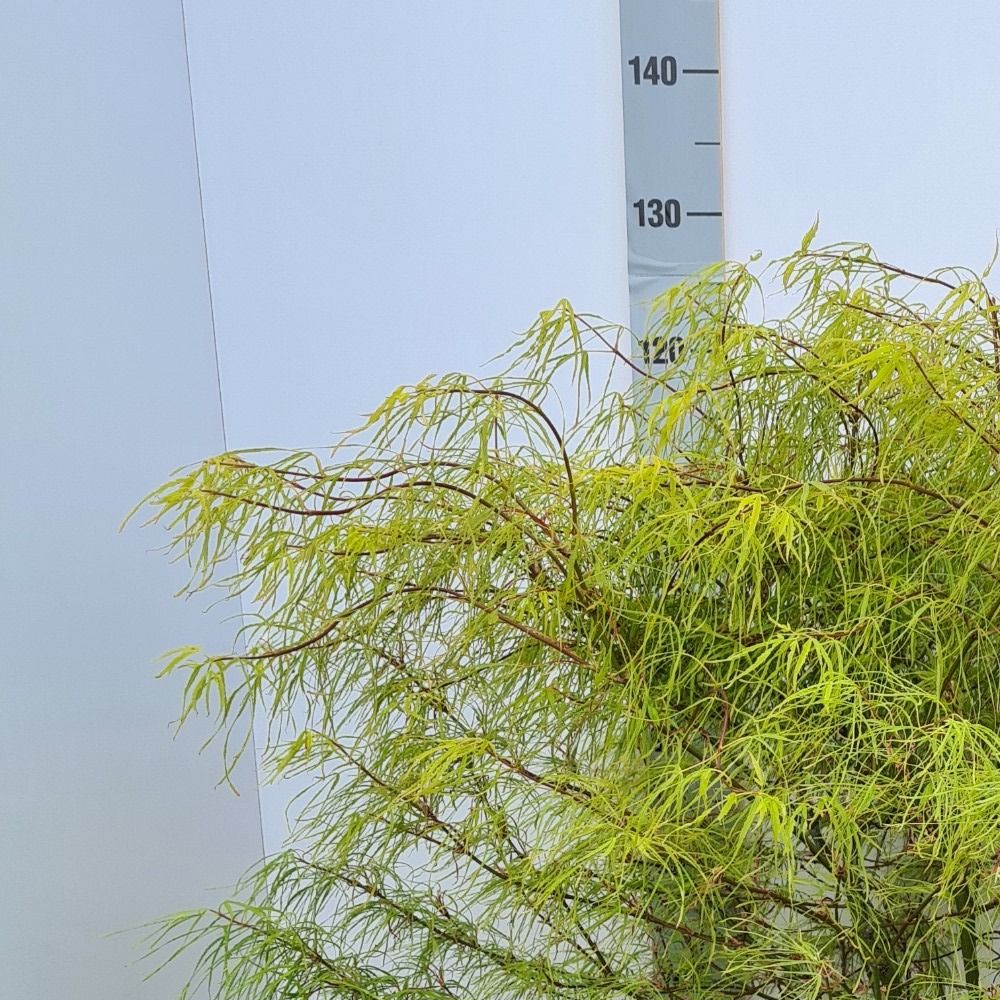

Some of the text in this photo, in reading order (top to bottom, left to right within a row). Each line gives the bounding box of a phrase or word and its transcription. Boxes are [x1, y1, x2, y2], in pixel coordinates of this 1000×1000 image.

[628, 56, 677, 85] 140
[633, 199, 681, 227] 130
[639, 337, 685, 364] 120
